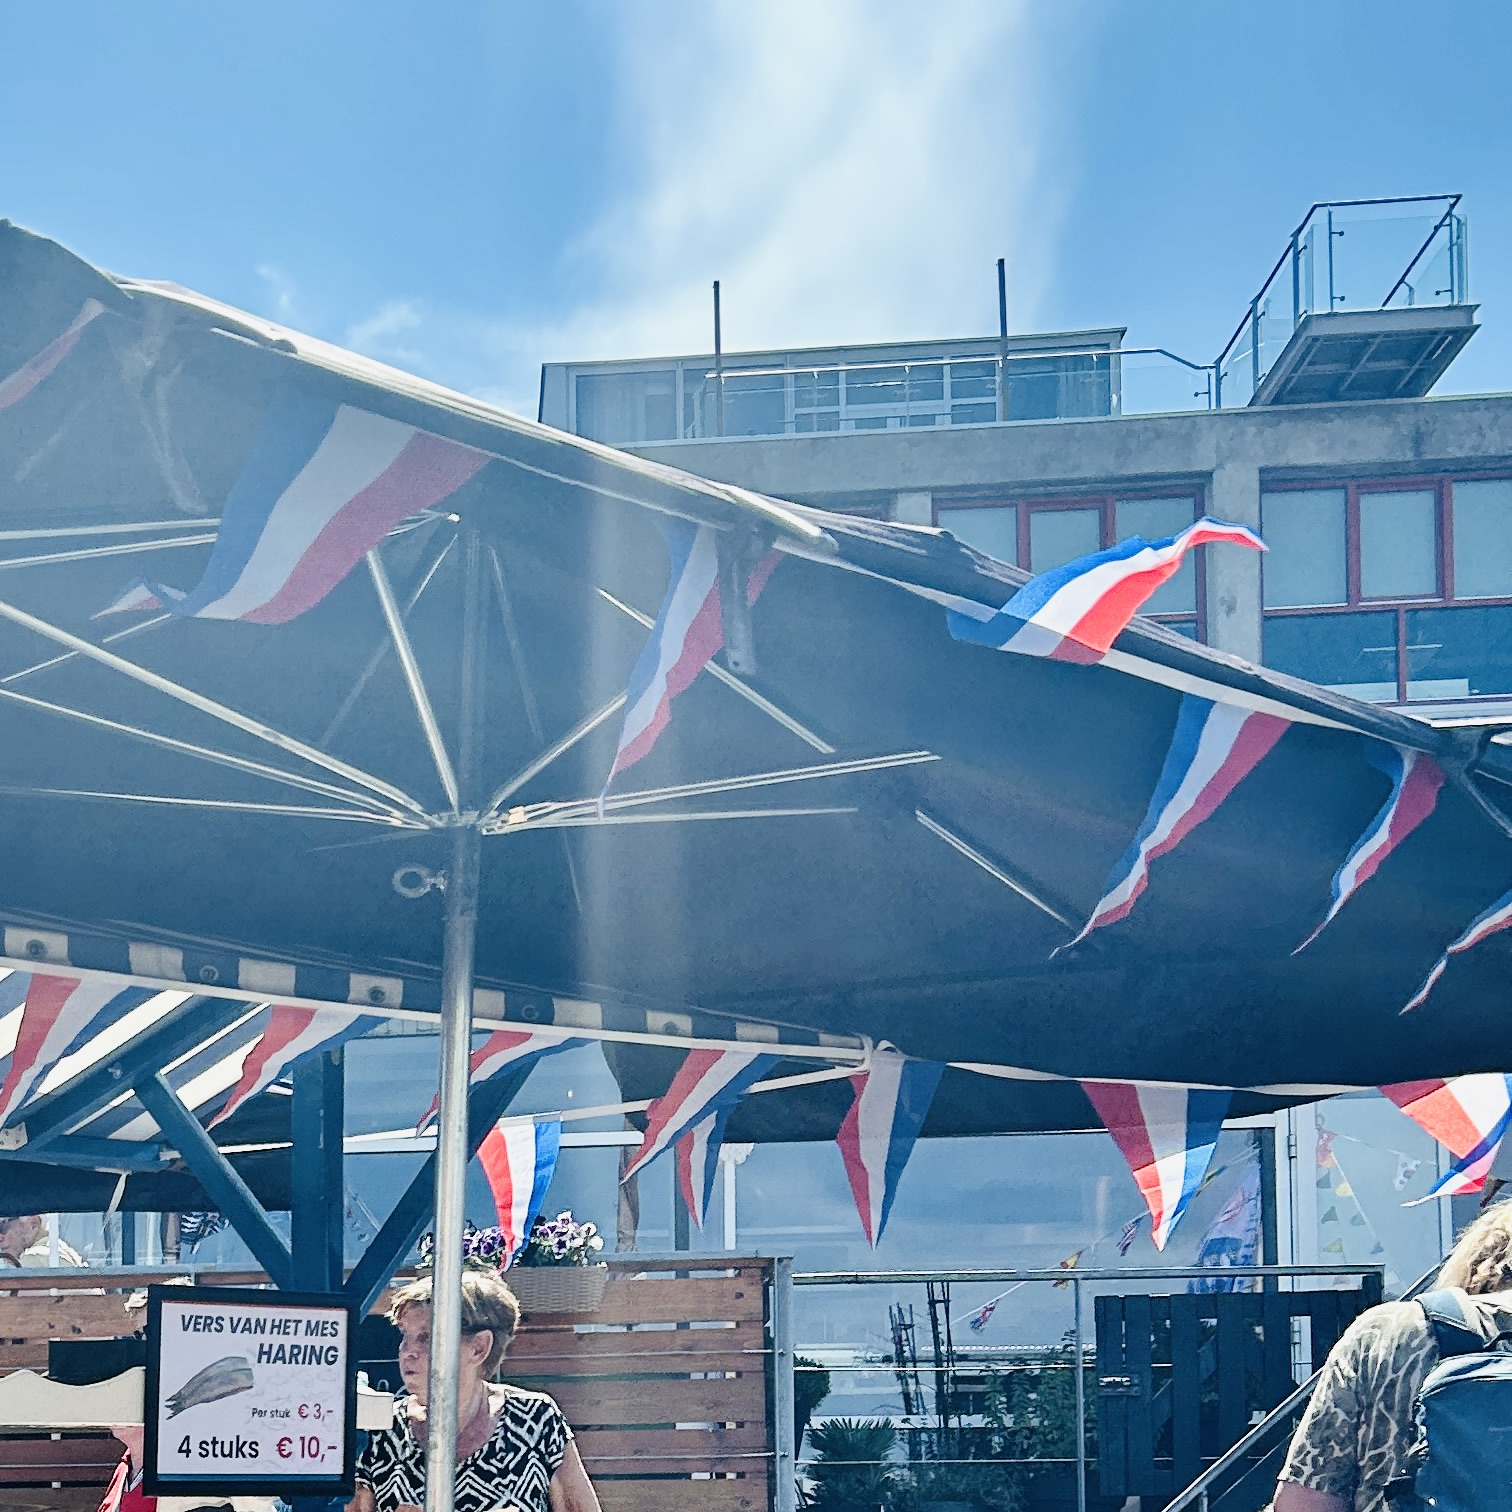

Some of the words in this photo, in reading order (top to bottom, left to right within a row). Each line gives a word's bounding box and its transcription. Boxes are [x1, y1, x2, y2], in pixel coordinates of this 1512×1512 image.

[181, 1315, 224, 1333] VERS
[229, 1316, 266, 1335] VAN
[270, 1319, 302, 1336] HET
[304, 1320, 340, 1338] MES
[257, 1342, 339, 1366] HARING
[252, 1407, 268, 1419] Per
[270, 1407, 291, 1419] stuk
[178, 1435, 192, 1458] 4
[198, 1435, 260, 1459] stuks
